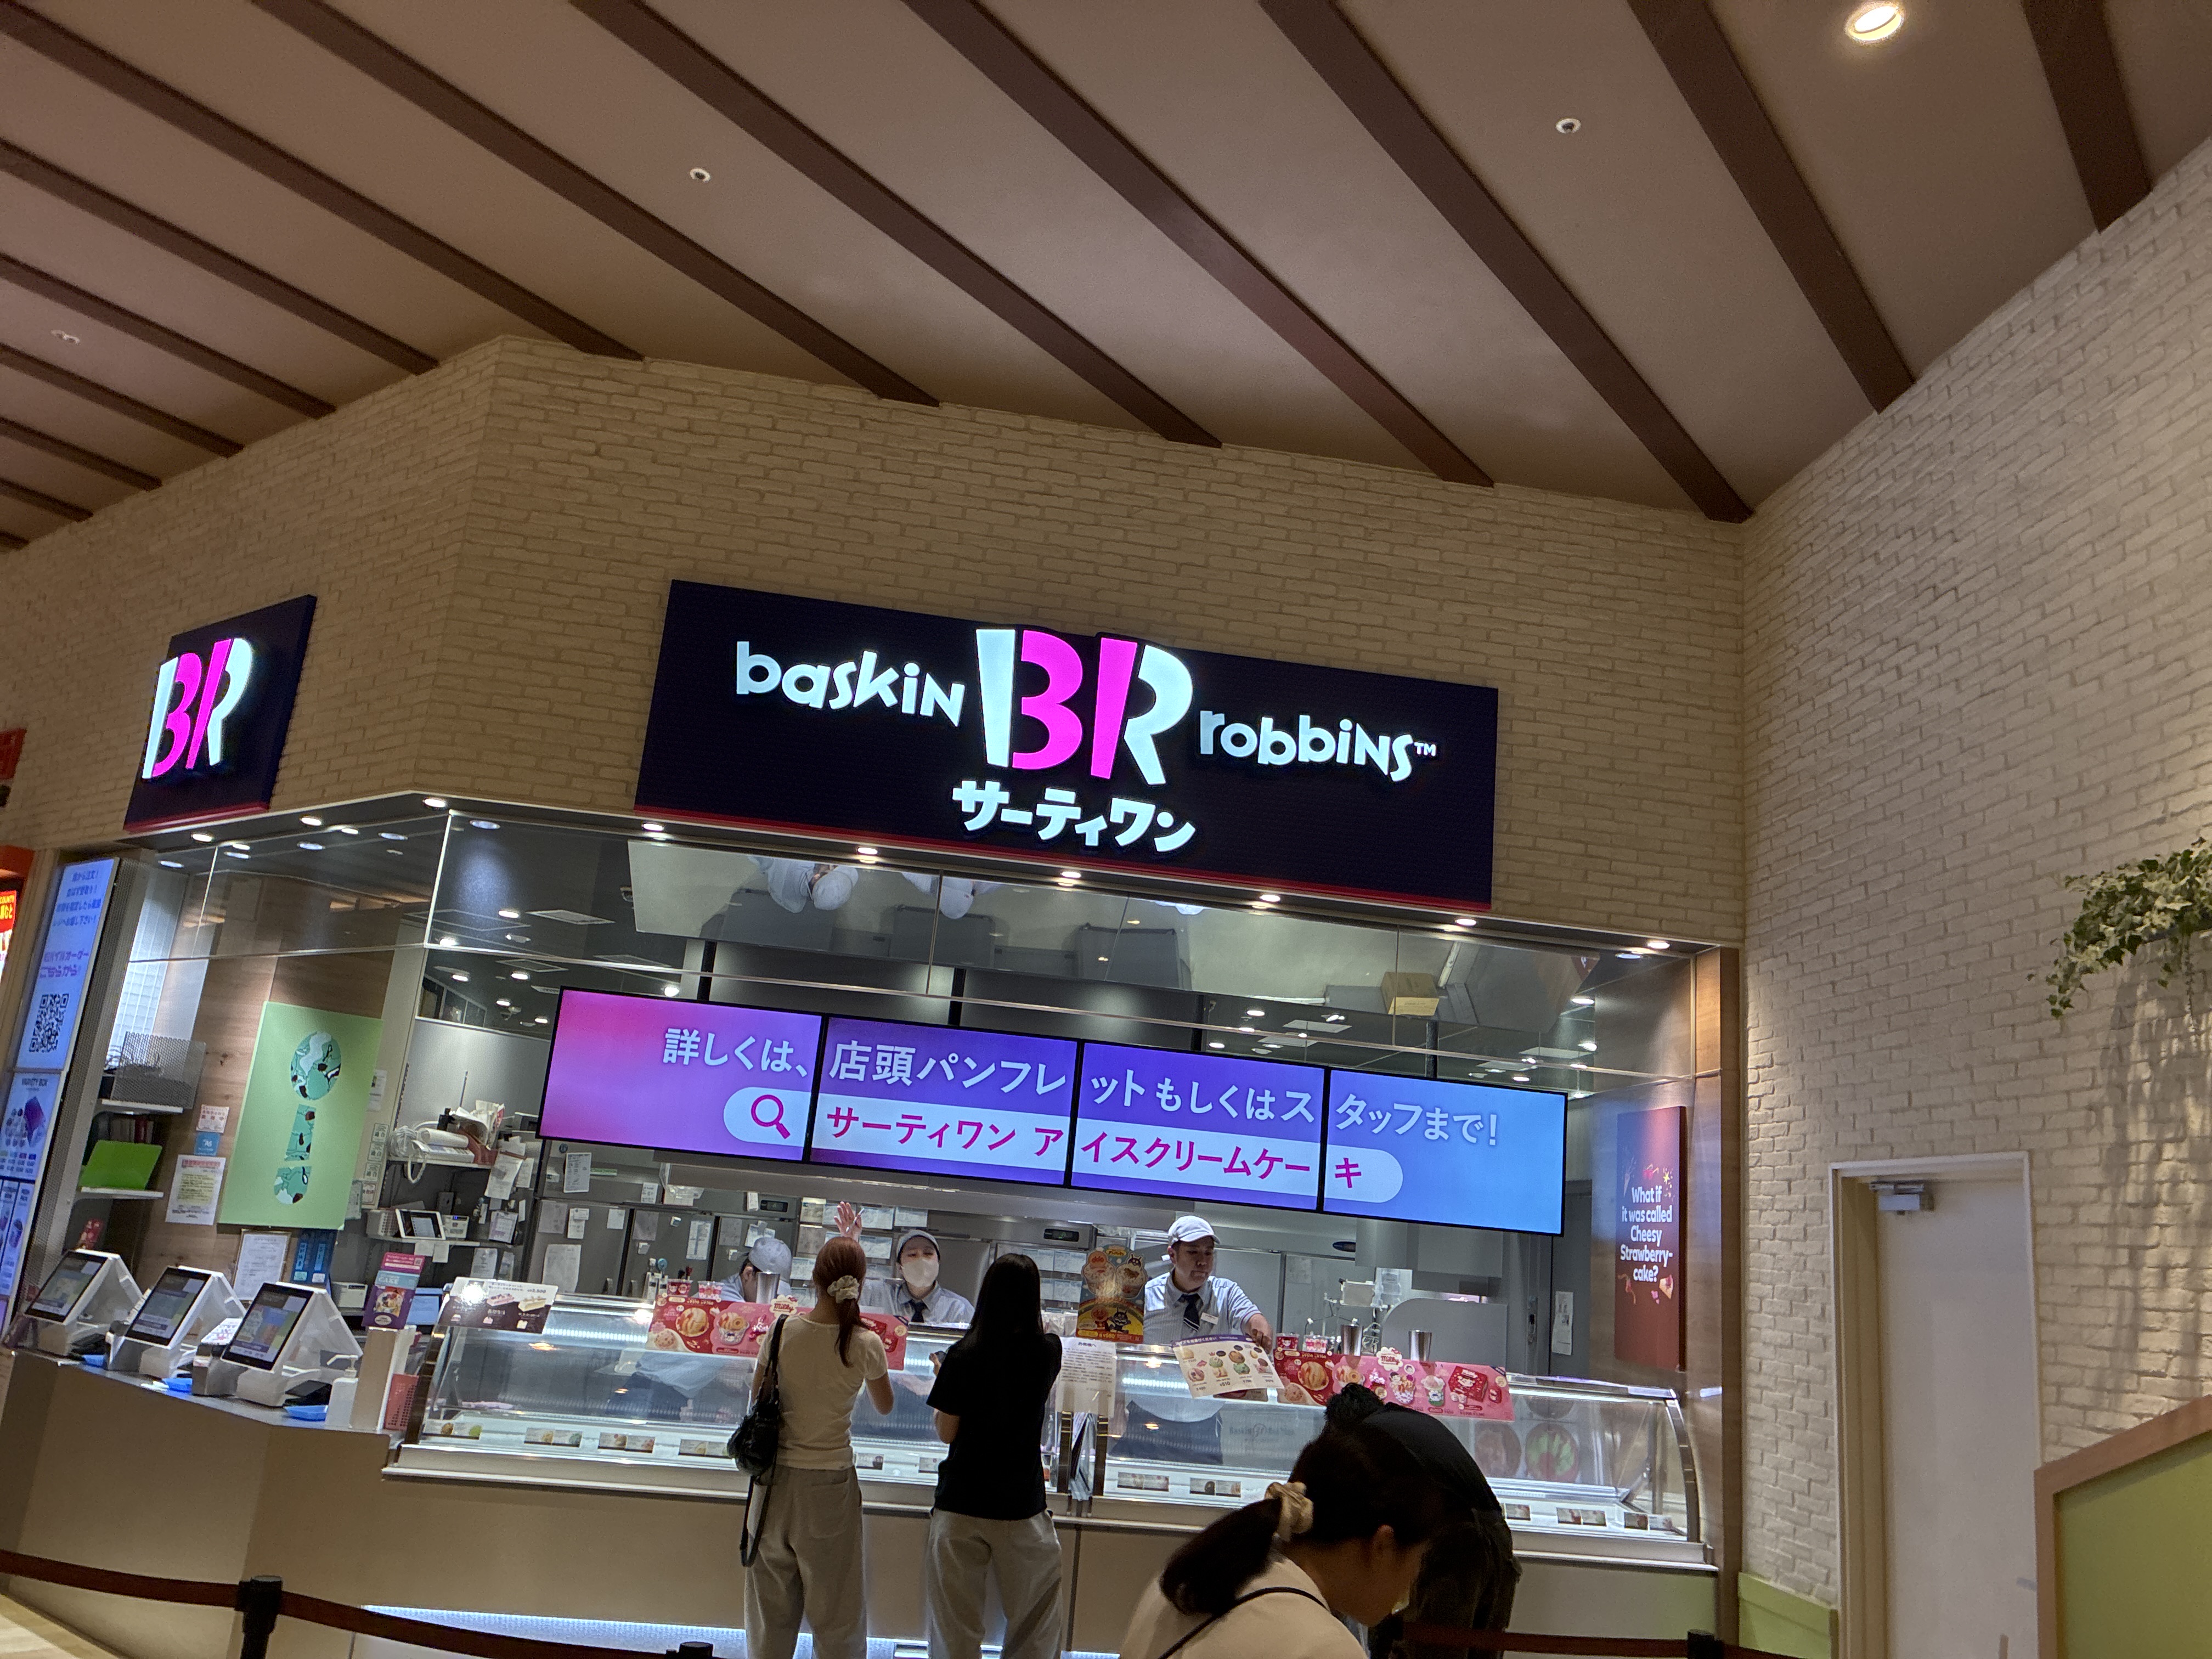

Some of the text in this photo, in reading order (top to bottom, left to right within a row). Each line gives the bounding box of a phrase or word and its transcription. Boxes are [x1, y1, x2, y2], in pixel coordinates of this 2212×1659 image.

[142, 638, 253, 778] BR
[976, 629, 1193, 785] BR
[953, 781, 1195, 853] サーティワン
[663, 1028, 808, 1077] 詳しくは、
[827, 1106, 1015, 1151] サーティワン
[1632, 1186, 1662, 1203] What if
[1622, 1205, 1673, 1223] it was called
[1630, 1225, 1662, 1247] Cheesy
[1620, 1244, 1673, 1268] Strawberry-
[1633, 1264, 1659, 1283] cake?
